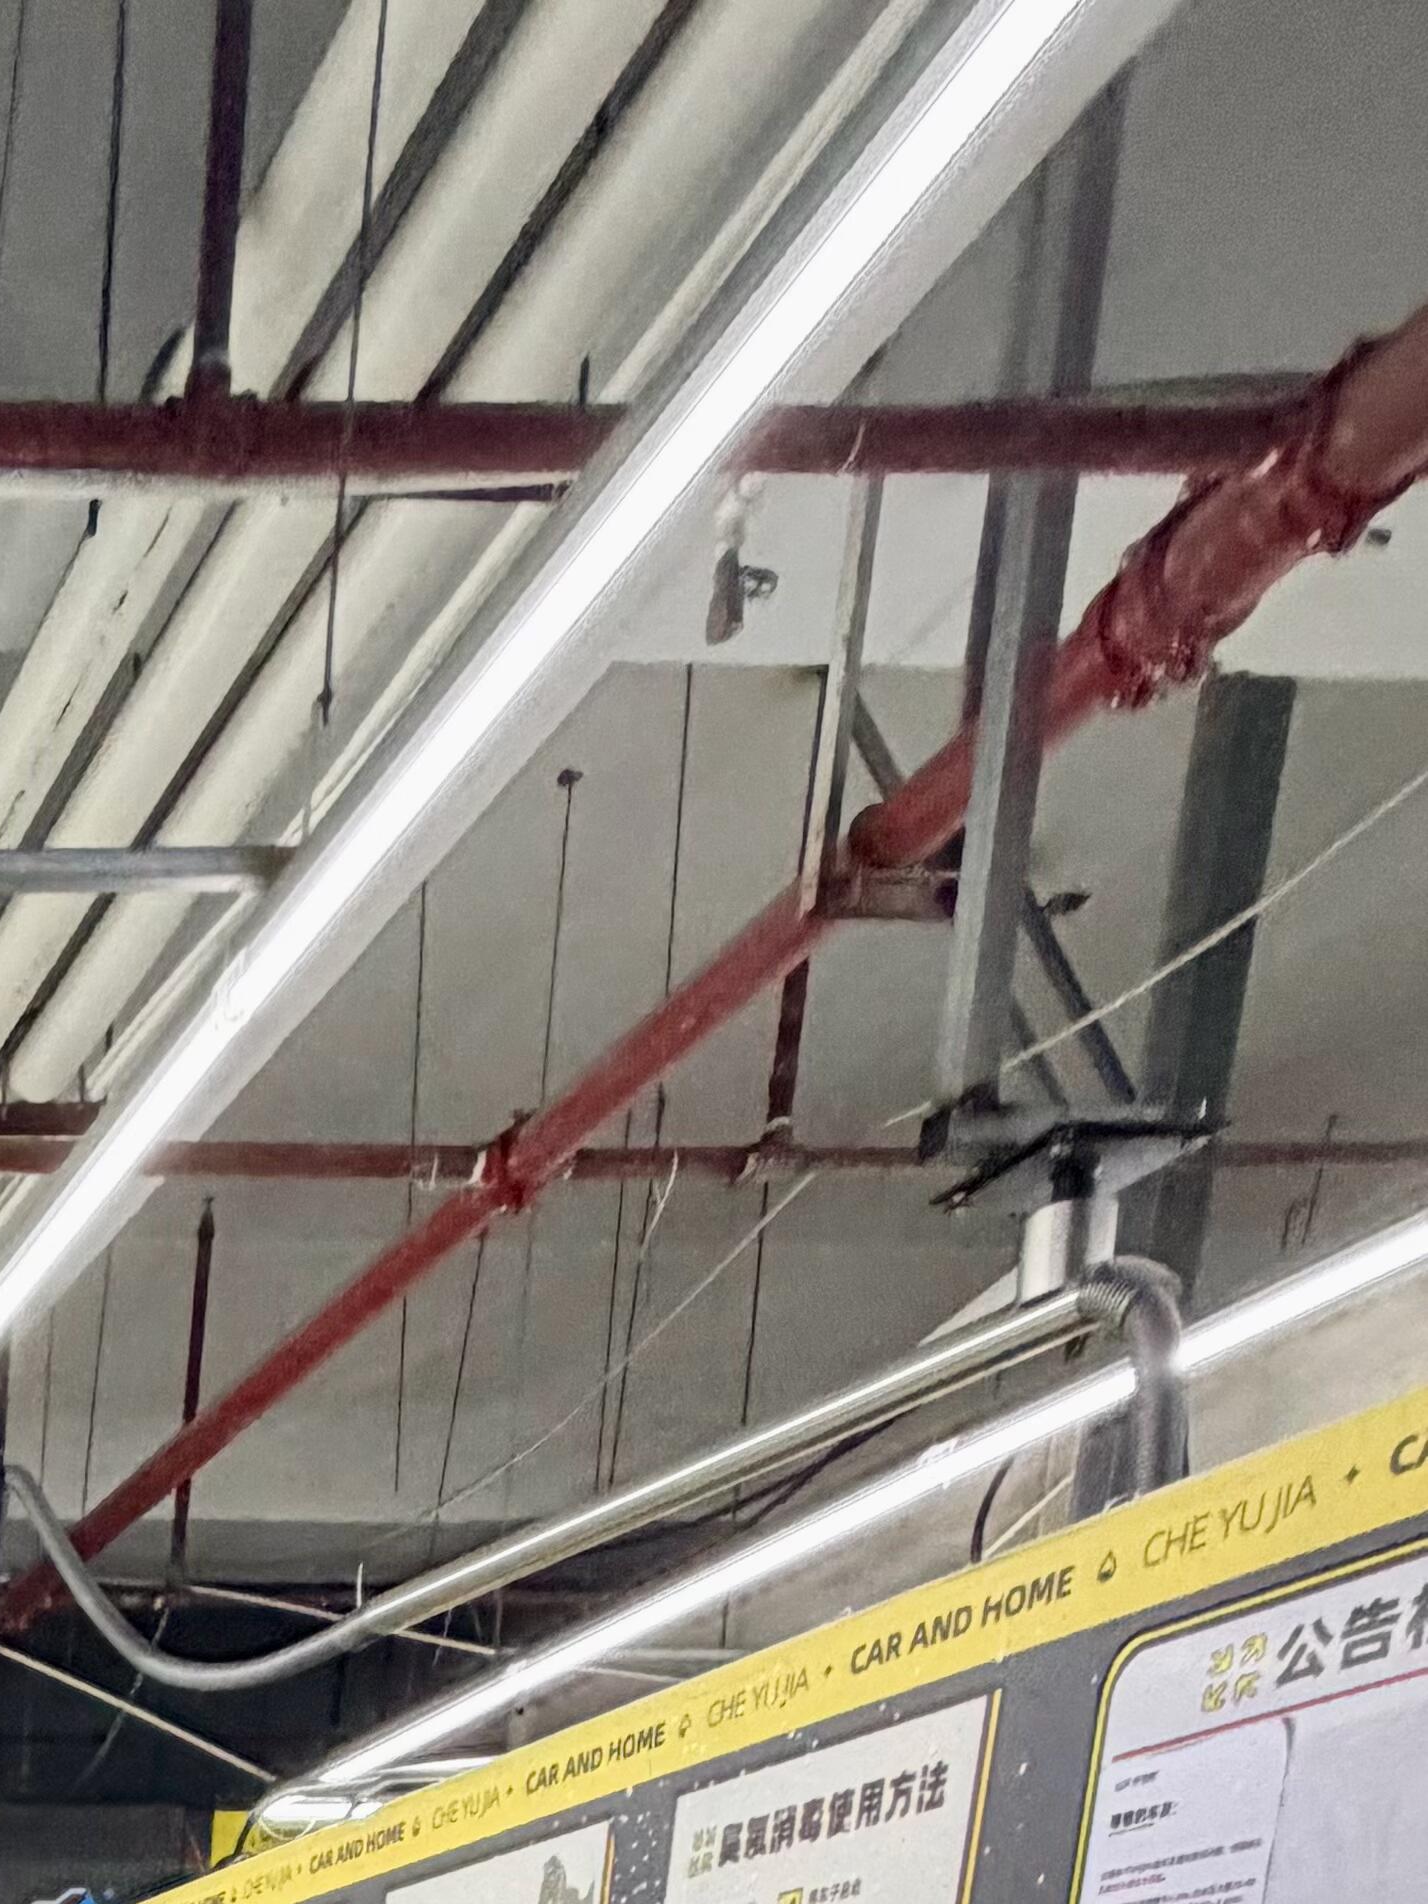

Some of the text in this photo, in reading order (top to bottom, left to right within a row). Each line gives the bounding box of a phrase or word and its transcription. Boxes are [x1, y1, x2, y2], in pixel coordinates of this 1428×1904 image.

[309, 1853, 333, 1874] CAR
[335, 1842, 364, 1864] AND
[365, 1821, 405, 1852] HOME
[526, 1763, 558, 1795] CAR
[562, 1747, 602, 1782] AND
[607, 1721, 666, 1764] HOME
[707, 1692, 746, 1727] CHE
[850, 1630, 902, 1675] CAR
[909, 1605, 973, 1655] AND
[980, 1564, 1075, 1627] HOME
[1142, 1515, 1209, 1569] CHE
